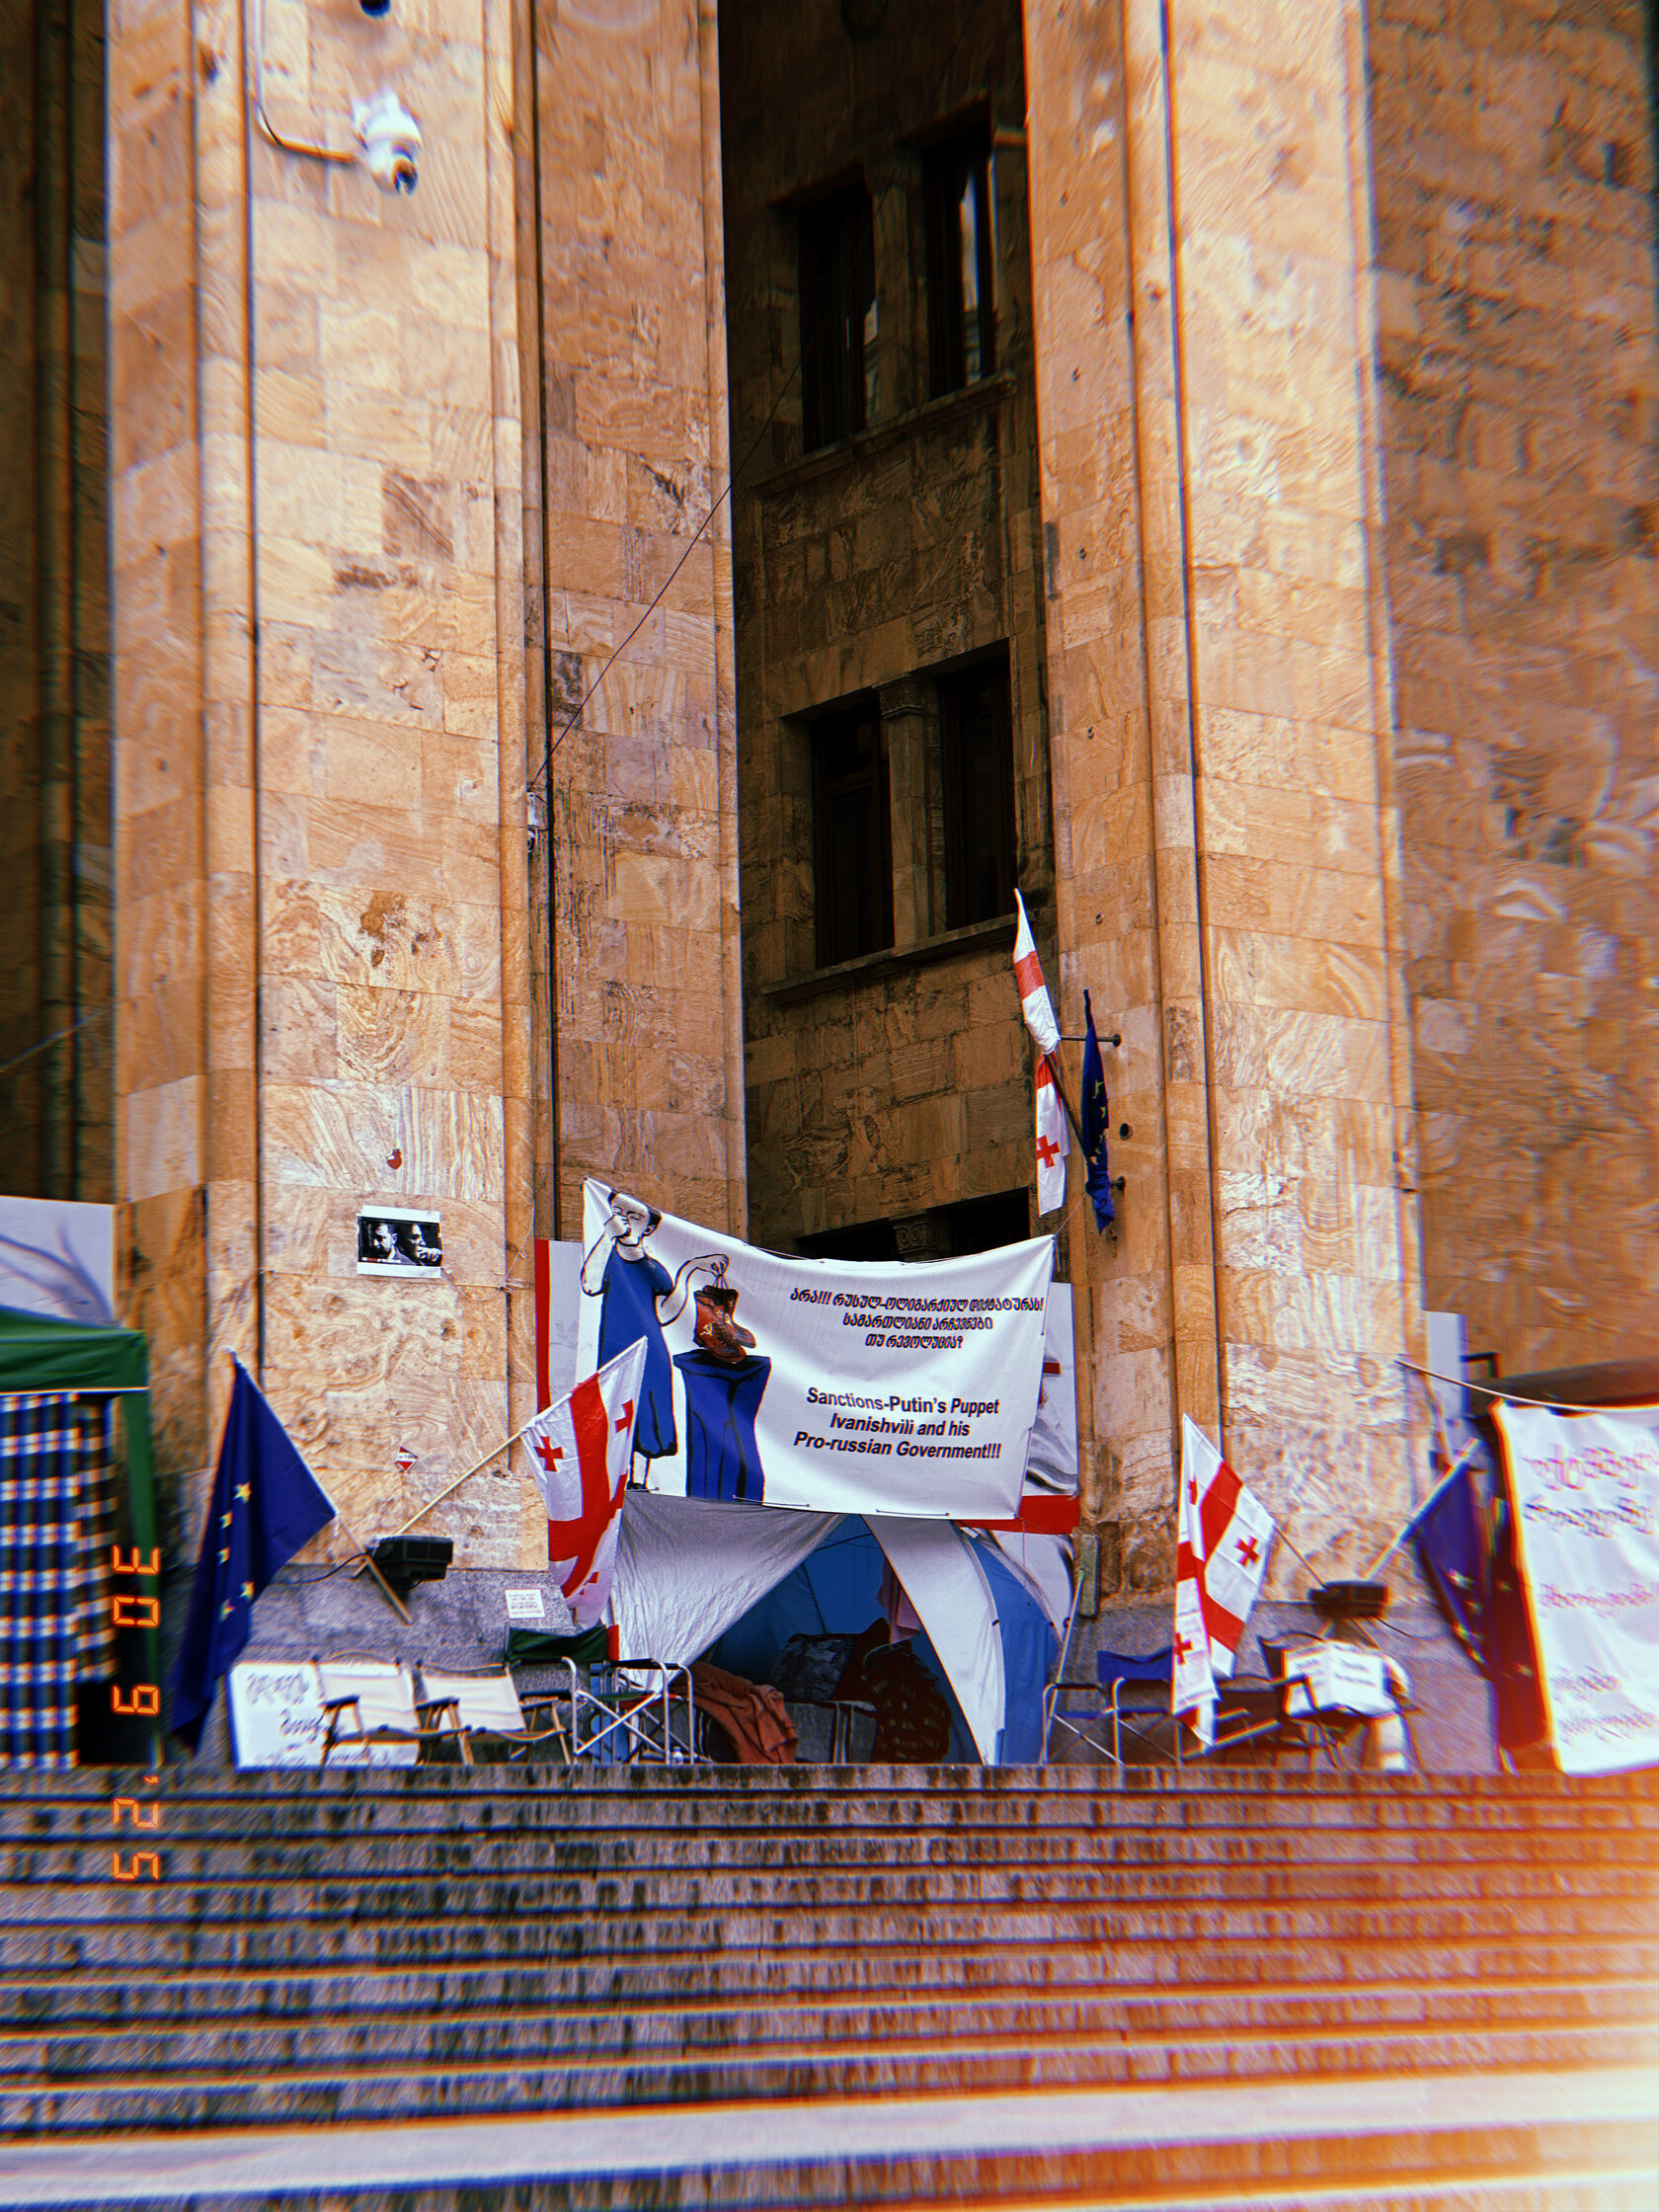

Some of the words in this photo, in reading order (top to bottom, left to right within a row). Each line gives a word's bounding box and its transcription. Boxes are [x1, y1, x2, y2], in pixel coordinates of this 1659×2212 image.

[790, 1288, 832, 1304] არა!!!
[832, 1293, 969, 1311] რუსულ-ოლიგარქიულ
[969, 1297, 1045, 1311] დიქტატურას!
[842, 1312, 932, 1330] სამართლიანი
[932, 1316, 993, 1331] არჩევნები
[865, 1333, 886, 1347] თუ
[886, 1334, 964, 1349] რევოლუცია?
[950, 1397, 1000, 1418] Puppet
[830, 1412, 915, 1435] Ivanishvili
[916, 1420, 947, 1436] and
[948, 1420, 971, 1437] his
[793, 1431, 893, 1455] Pro-russian
[896, 1441, 1002, 1459] Government!!!
